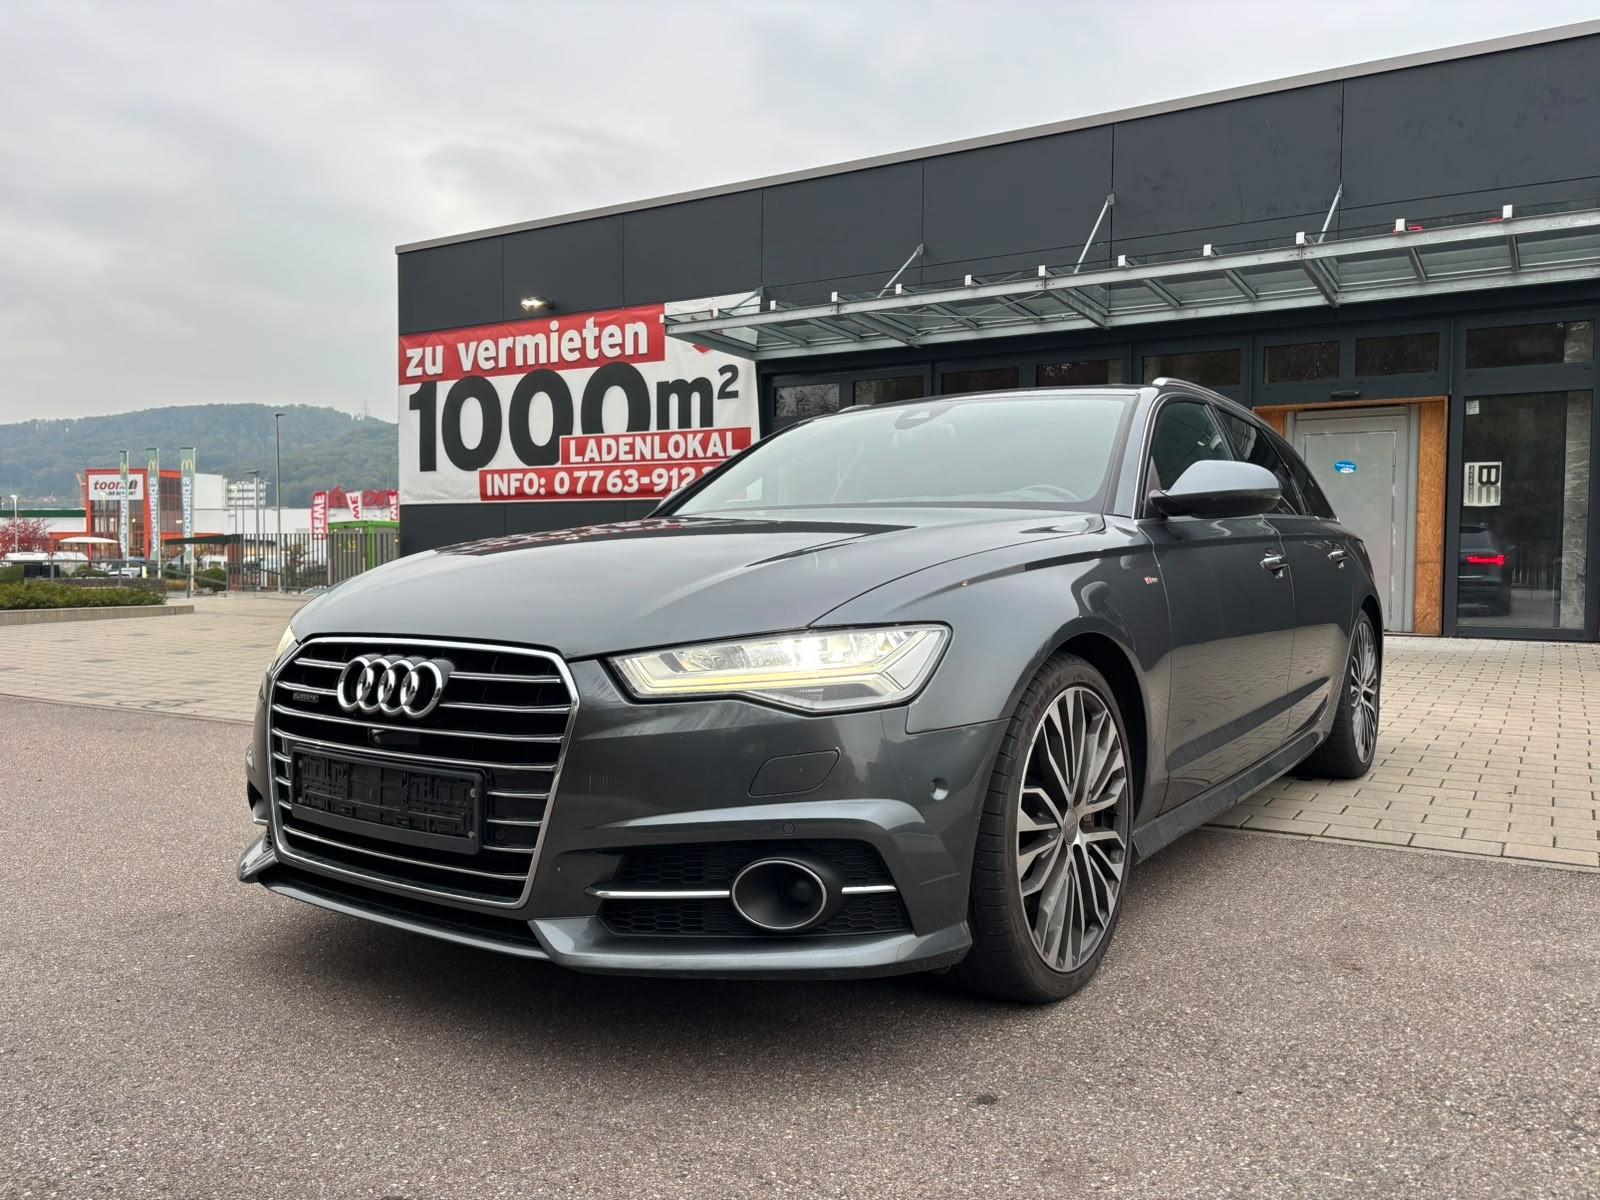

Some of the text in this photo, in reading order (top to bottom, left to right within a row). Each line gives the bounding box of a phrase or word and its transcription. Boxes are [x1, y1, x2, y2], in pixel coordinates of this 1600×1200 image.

[406, 316, 649, 377] zu vermieten
[569, 431, 742, 462] LADENLOKAL
[486, 466, 714, 496] INFO: 07763-912
